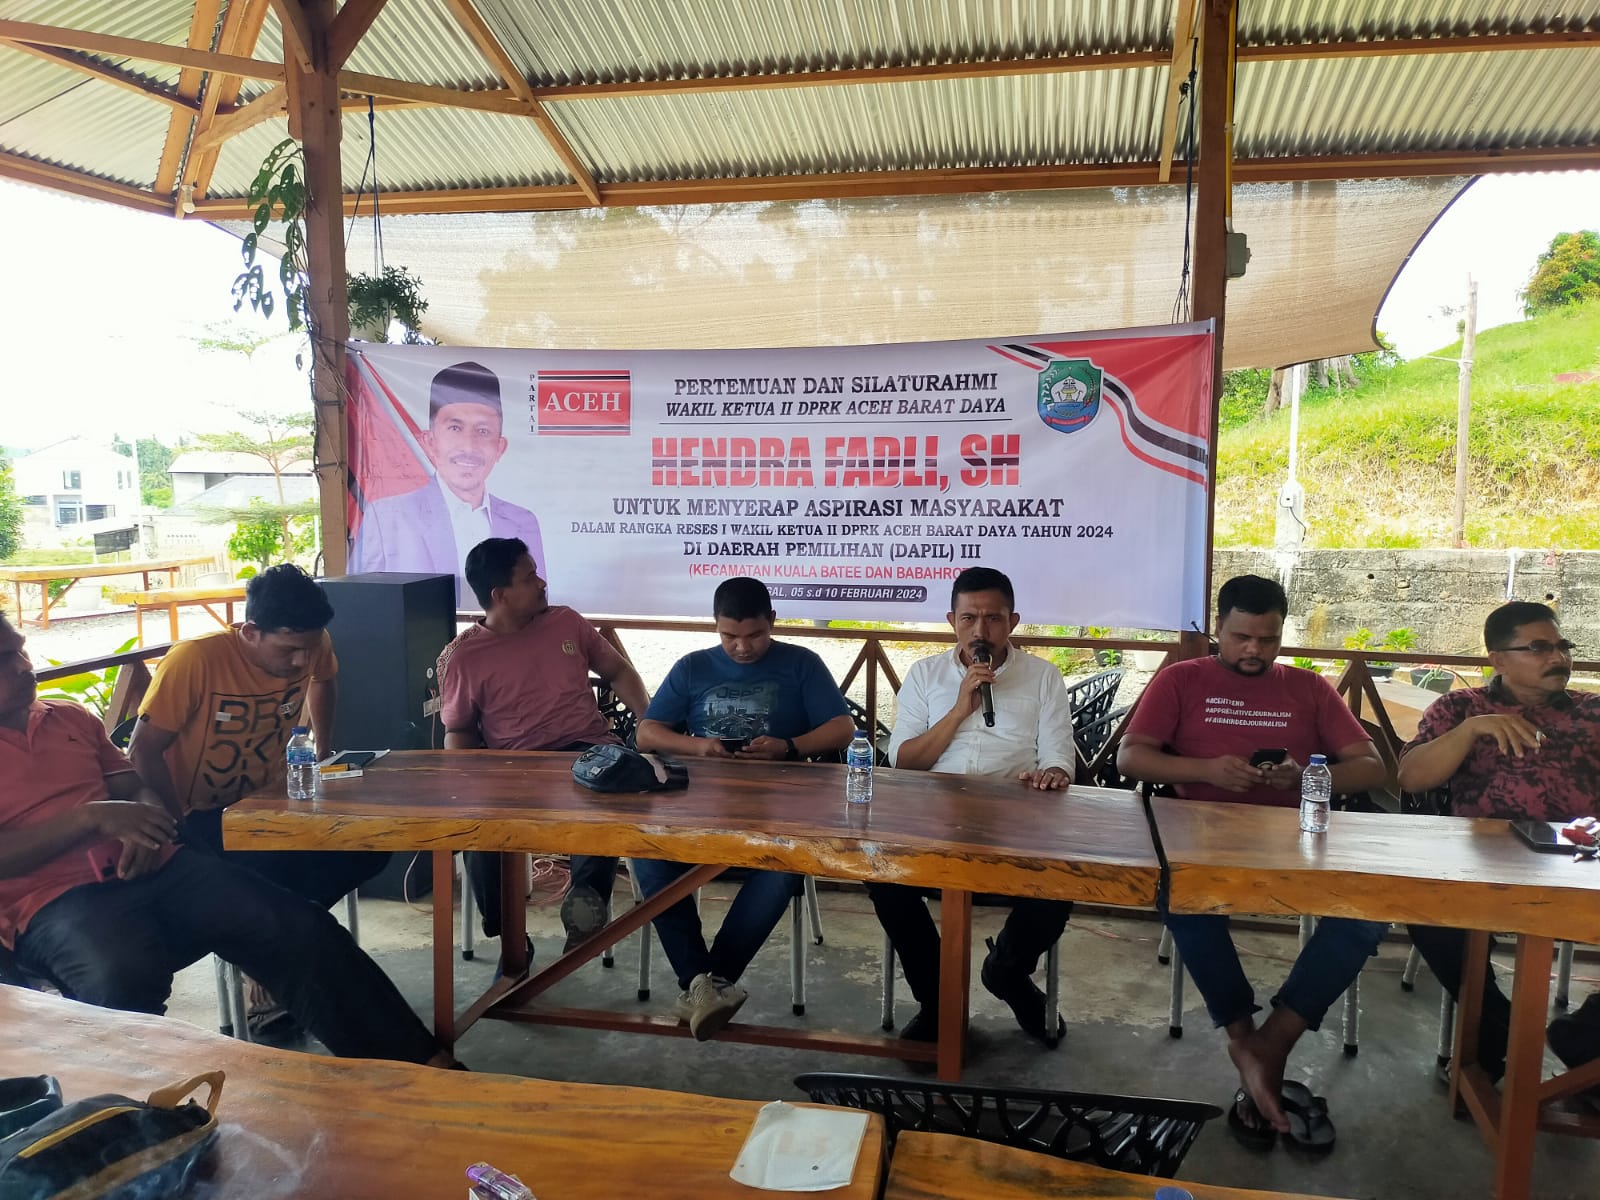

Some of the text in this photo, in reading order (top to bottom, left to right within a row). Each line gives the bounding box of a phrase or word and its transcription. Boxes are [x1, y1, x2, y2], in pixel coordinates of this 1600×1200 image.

[674, 373, 998, 396] PERTEMUAN DAN SILATURAHMI
[528, 374, 536, 433] PARTAI
[544, 392, 622, 412] ACEH
[666, 398, 1006, 417] WAKIL KETUA II DPRK ACEH BARAT DAYA
[652, 434, 1021, 493] HENDRA FADLI, SH
[613, 498, 1064, 518] UNTUK MENYERAP ASPIRASI MASYARAKAT
[571, 522, 1114, 538] DALAM RANGKA RESES I WAKIL KETUA II DPRK ACEH BARAT DAYA TAHUN 2024
[684, 542, 981, 562] DI DAERAH PEMILIHAN (DAPIL) III
[689, 564, 970, 580] (KECAMATAN KUALA BATEE DAN BABAHRO
[766, 586, 923, 599] GAL, 05 s.d 10 FEBRUARI 2024
